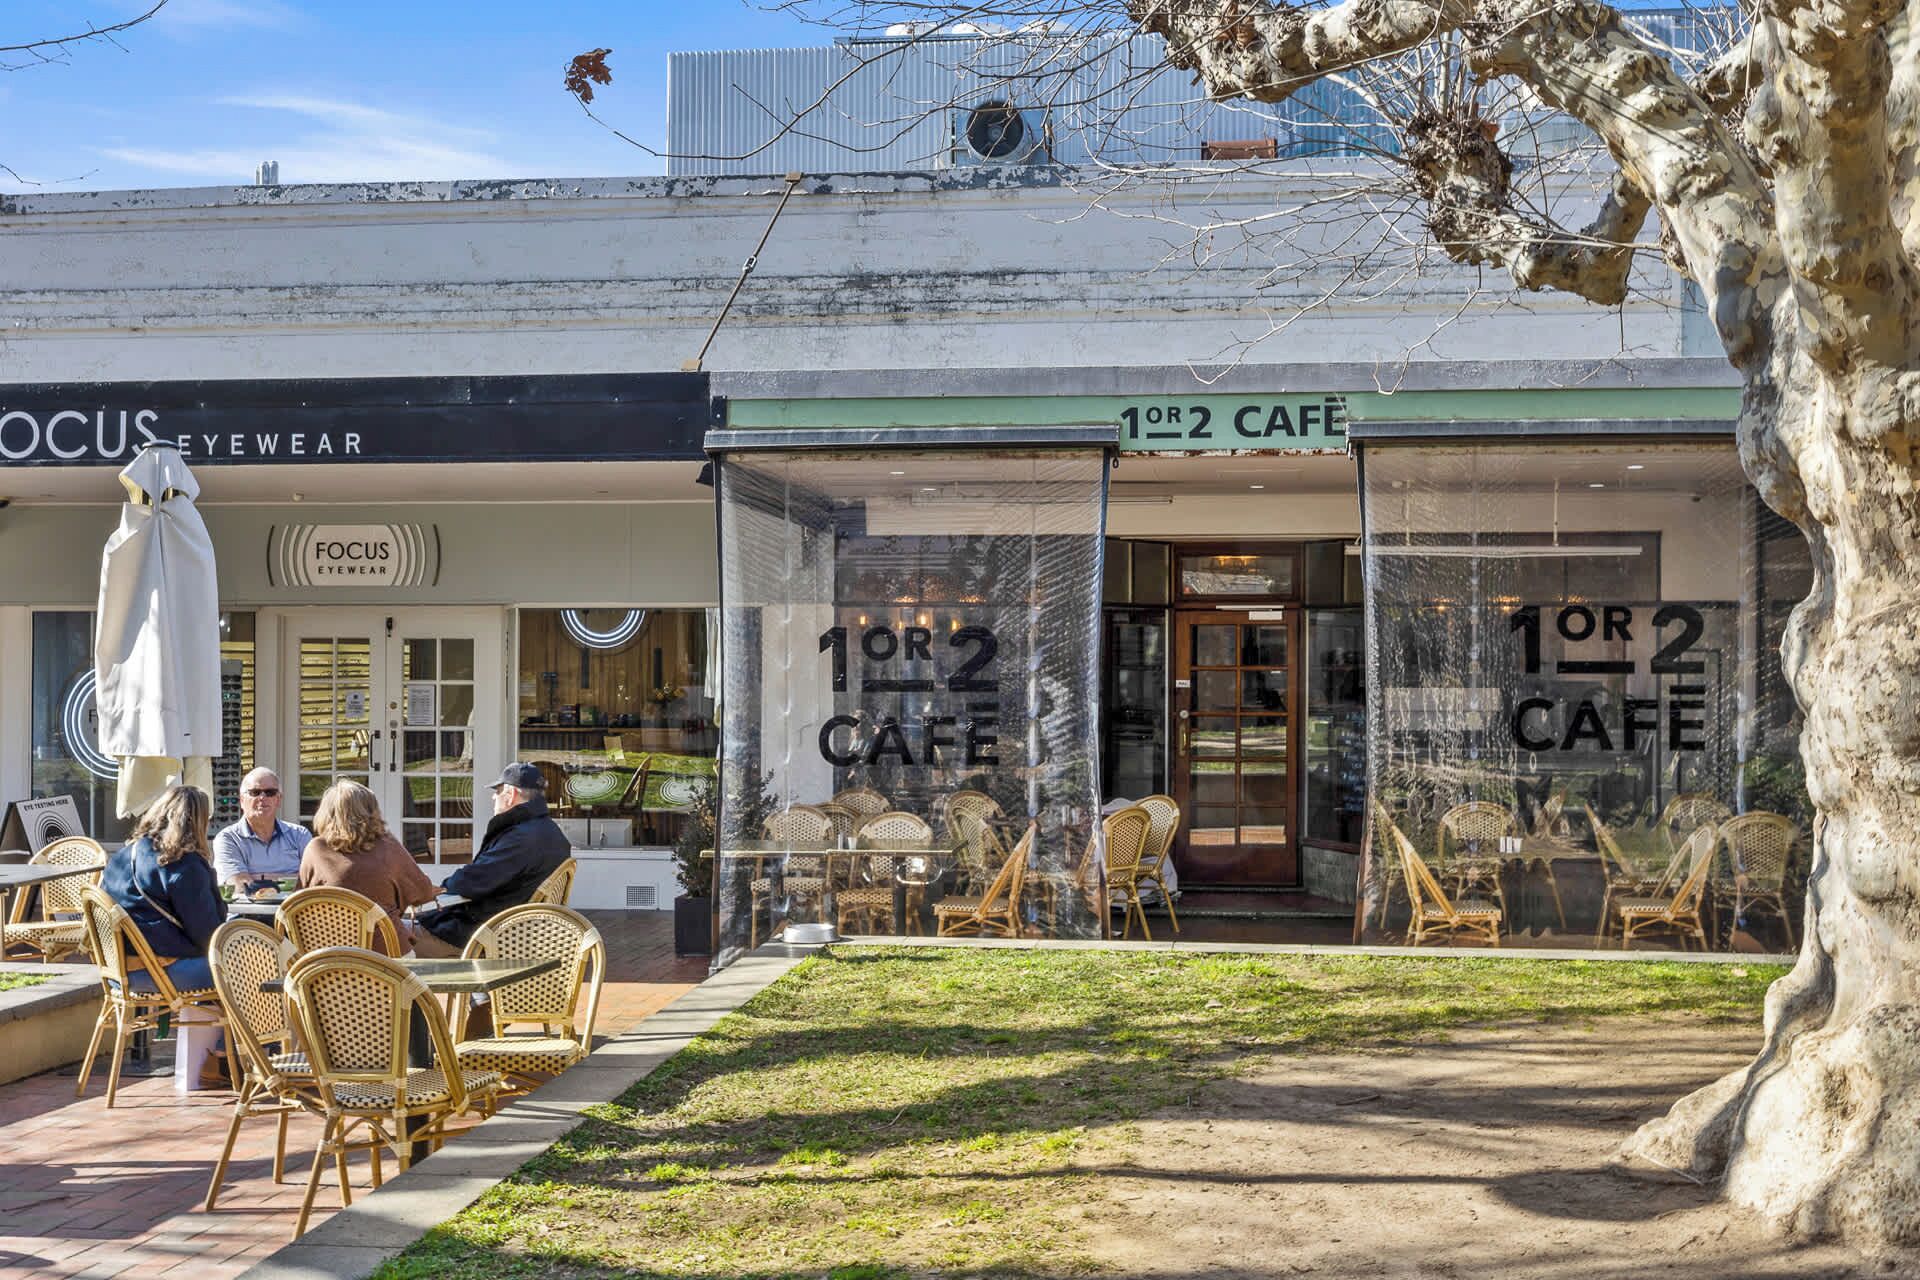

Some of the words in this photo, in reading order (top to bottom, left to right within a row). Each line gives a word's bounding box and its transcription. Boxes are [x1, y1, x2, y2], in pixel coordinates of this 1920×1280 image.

[178, 432, 361, 456] EYEWEAR
[316, 542, 389, 560] FOCUS
[318, 565, 386, 575] EYEWEAR
